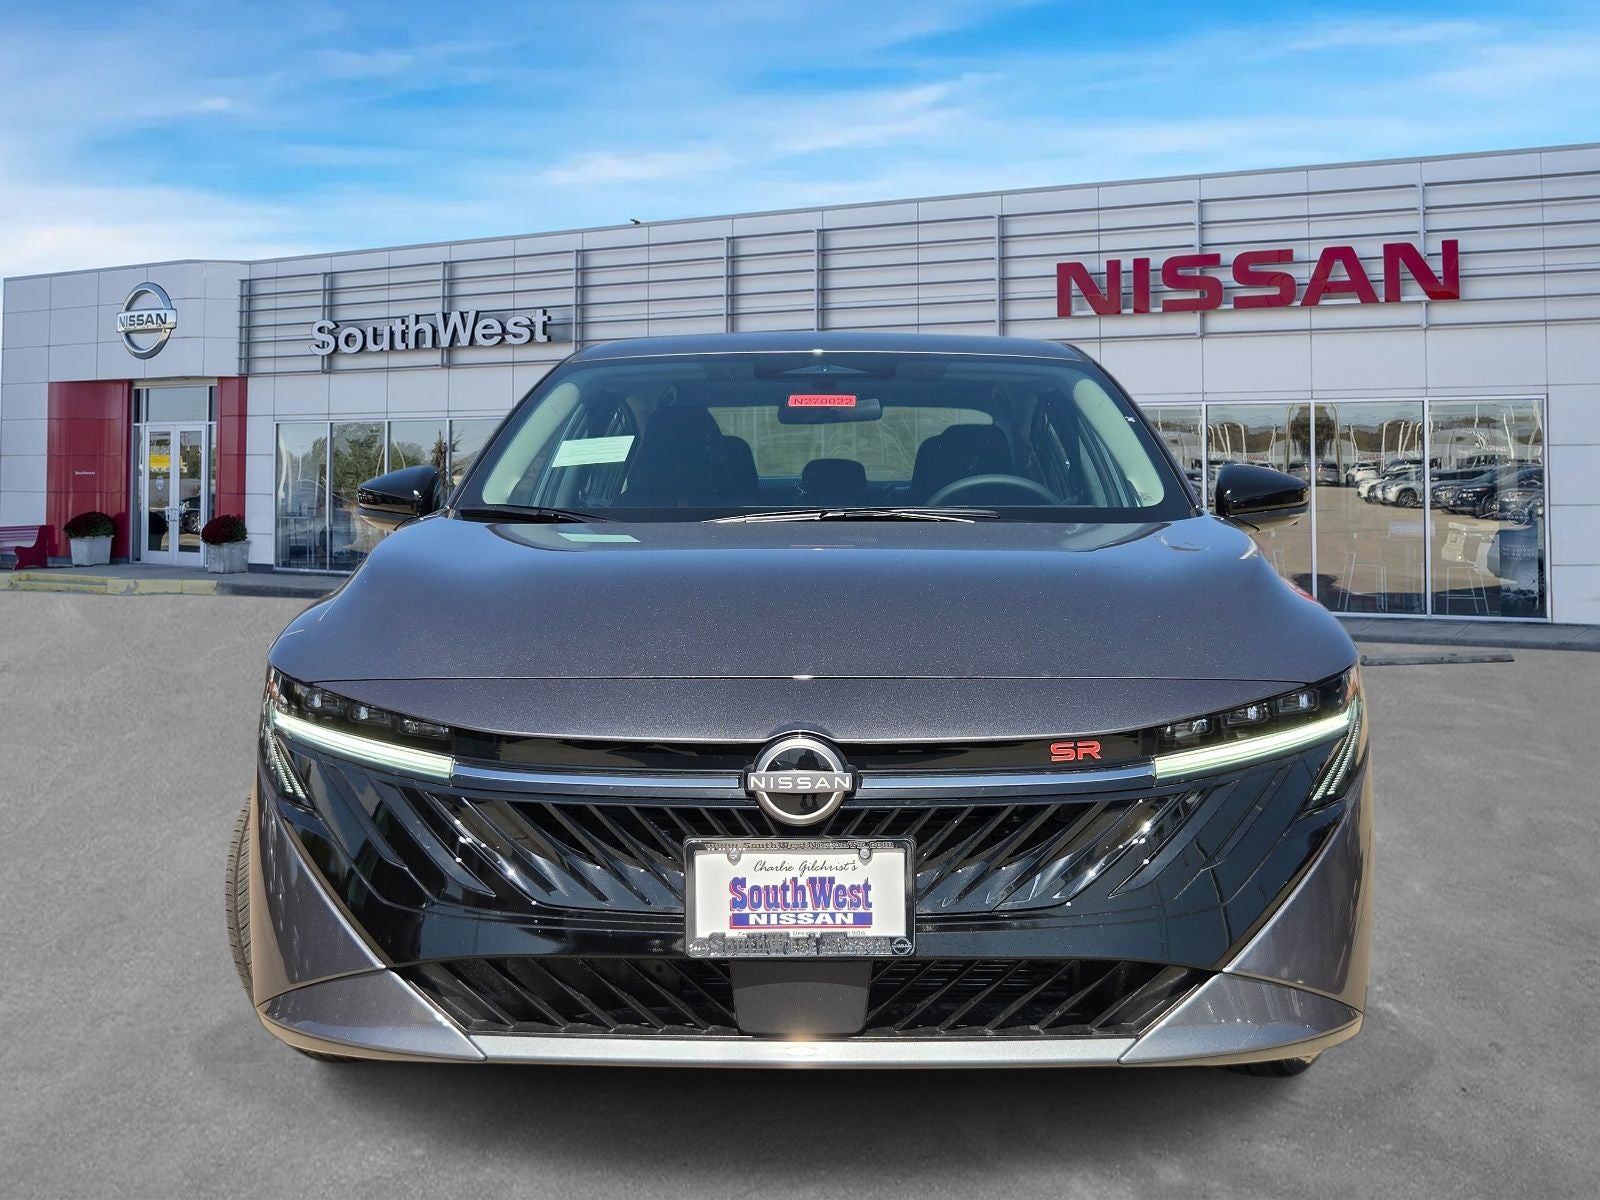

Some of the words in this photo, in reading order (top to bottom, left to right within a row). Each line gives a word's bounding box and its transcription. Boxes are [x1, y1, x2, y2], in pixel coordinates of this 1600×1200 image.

[1056, 239, 1460, 317] NISSAN
[119, 312, 167, 328] NISSAN
[308, 308, 552, 356] SouthWest
[1050, 740, 1101, 761] SR
[750, 776, 850, 789] NISSAN
[753, 860, 794, 872] Charlie
[799, 860, 859, 877] Gilchrist's
[729, 876, 872, 912] SouthWest
[749, 912, 854, 925] NISSAN
